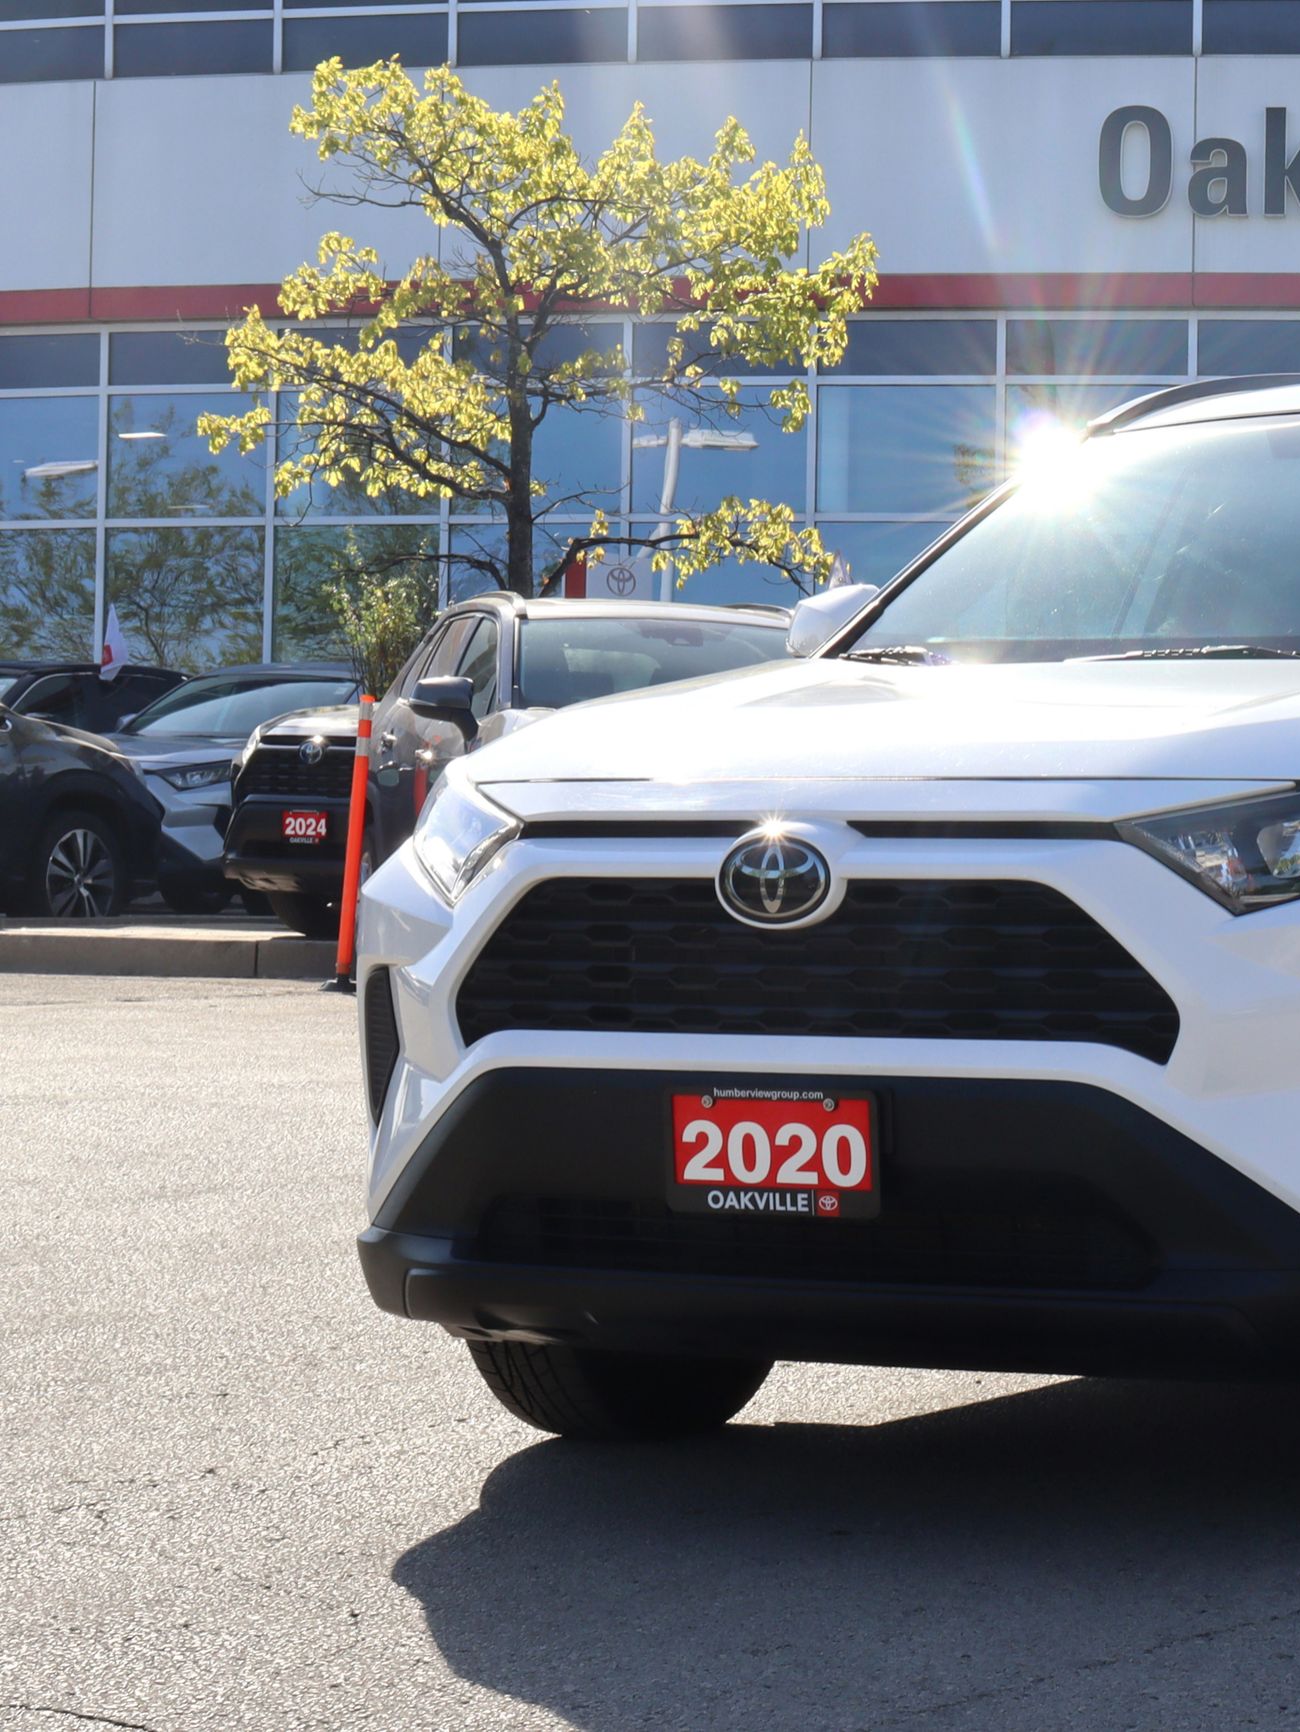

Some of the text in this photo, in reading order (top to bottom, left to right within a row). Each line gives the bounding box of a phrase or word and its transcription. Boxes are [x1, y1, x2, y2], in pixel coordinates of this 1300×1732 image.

[285, 817, 327, 836] 2024
[713, 1087, 824, 1101] humberviewgroup.com
[681, 1119, 867, 1188] 2020
[707, 1190, 809, 1212] OAKVILLE
